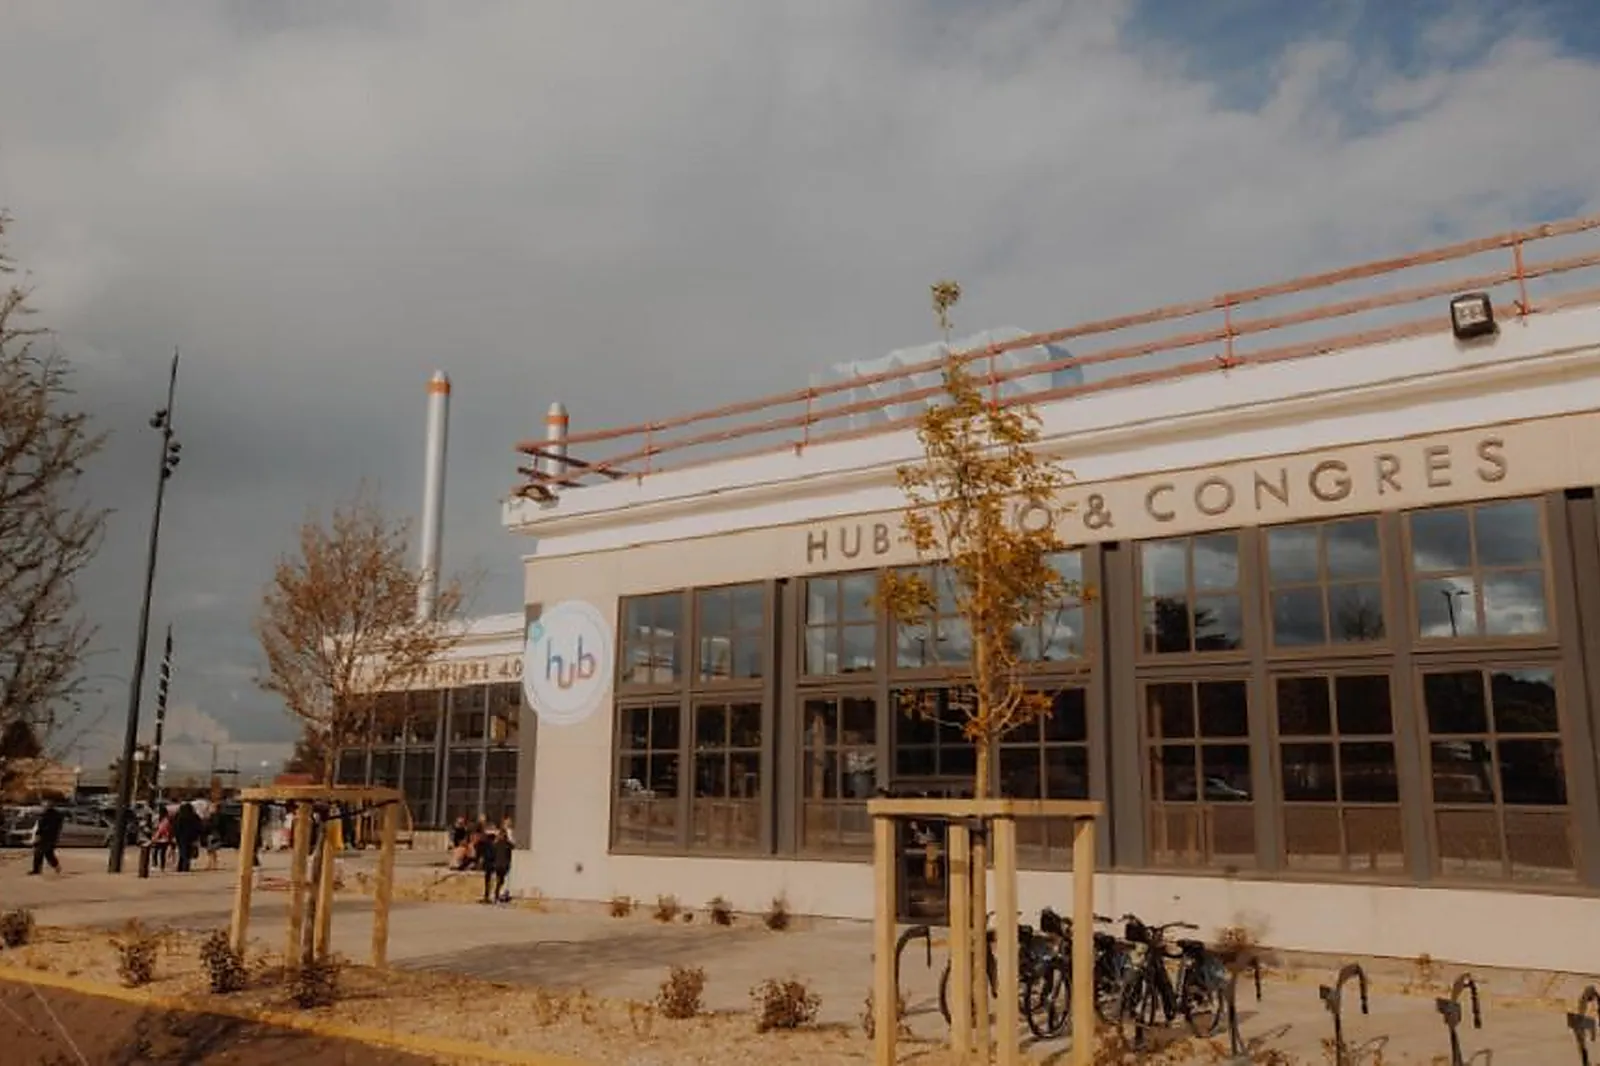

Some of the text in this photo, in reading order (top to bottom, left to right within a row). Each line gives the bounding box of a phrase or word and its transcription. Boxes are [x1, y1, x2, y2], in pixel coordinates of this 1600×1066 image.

[806, 524, 891, 563] HUB
[1083, 494, 1113, 530] &
[1145, 439, 1507, 522] CONGRES
[545, 633, 596, 689] hub
